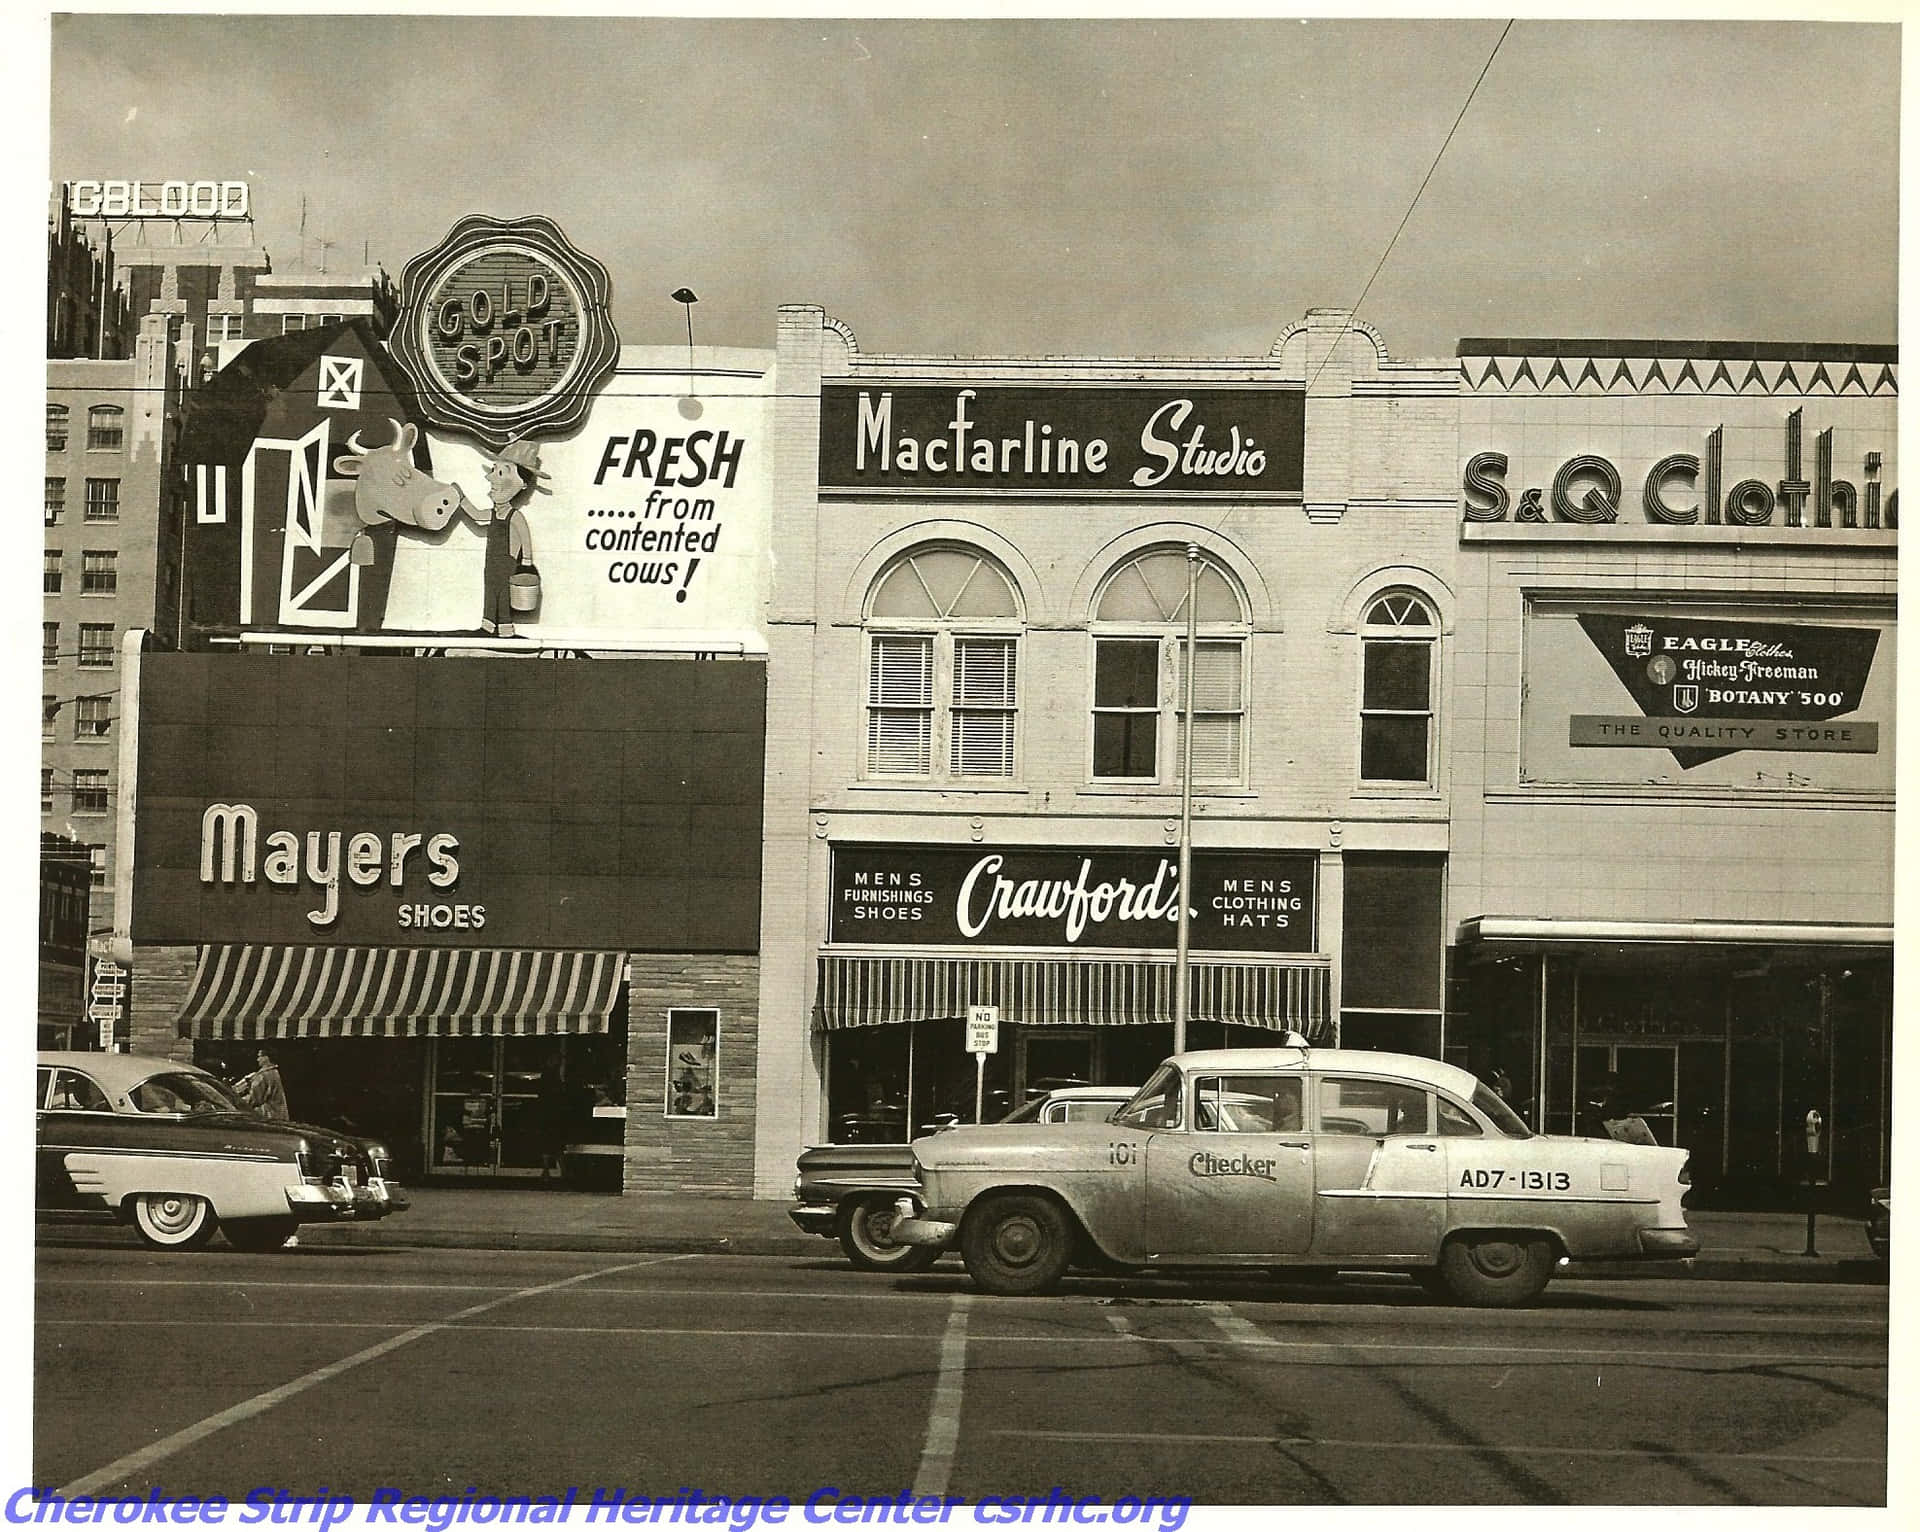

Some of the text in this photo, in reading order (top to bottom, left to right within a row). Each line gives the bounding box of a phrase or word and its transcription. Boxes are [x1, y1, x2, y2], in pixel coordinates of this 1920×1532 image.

[63, 180, 249, 217] GBLOOD
[438, 274, 550, 335] GOLD
[457, 319, 562, 380] SPOT
[856, 390, 1266, 488] Macfarline Studio
[593, 429, 745, 488] FRESH
[1643, 406, 1899, 529] Clothi
[585, 521, 722, 553] contented
[608, 558, 700, 603] cows!
[1663, 637, 1751, 652] EAGLE
[1745, 641, 1793, 659] Clothes
[1683, 659, 1818, 682] Hickey-Freeman
[1600, 723, 1853, 741] THE QUALITY STORE
[199, 803, 461, 926] Mayers
[855, 872, 922, 887] MENS
[1223, 879, 1292, 894] MENS
[844, 889, 934, 904] FURNISHINGS
[1212, 896, 1302, 911] CLOTHING
[398, 903, 487, 930] SHOES
[854, 906, 923, 920] SHOES
[1223, 914, 1290, 929] HATS
[976, 1013, 990, 1021] NO
[1109, 1143, 1138, 1164] 101
[1190, 1153, 1277, 1182] Checker
[1460, 1169, 1571, 1190] AD7-1313
